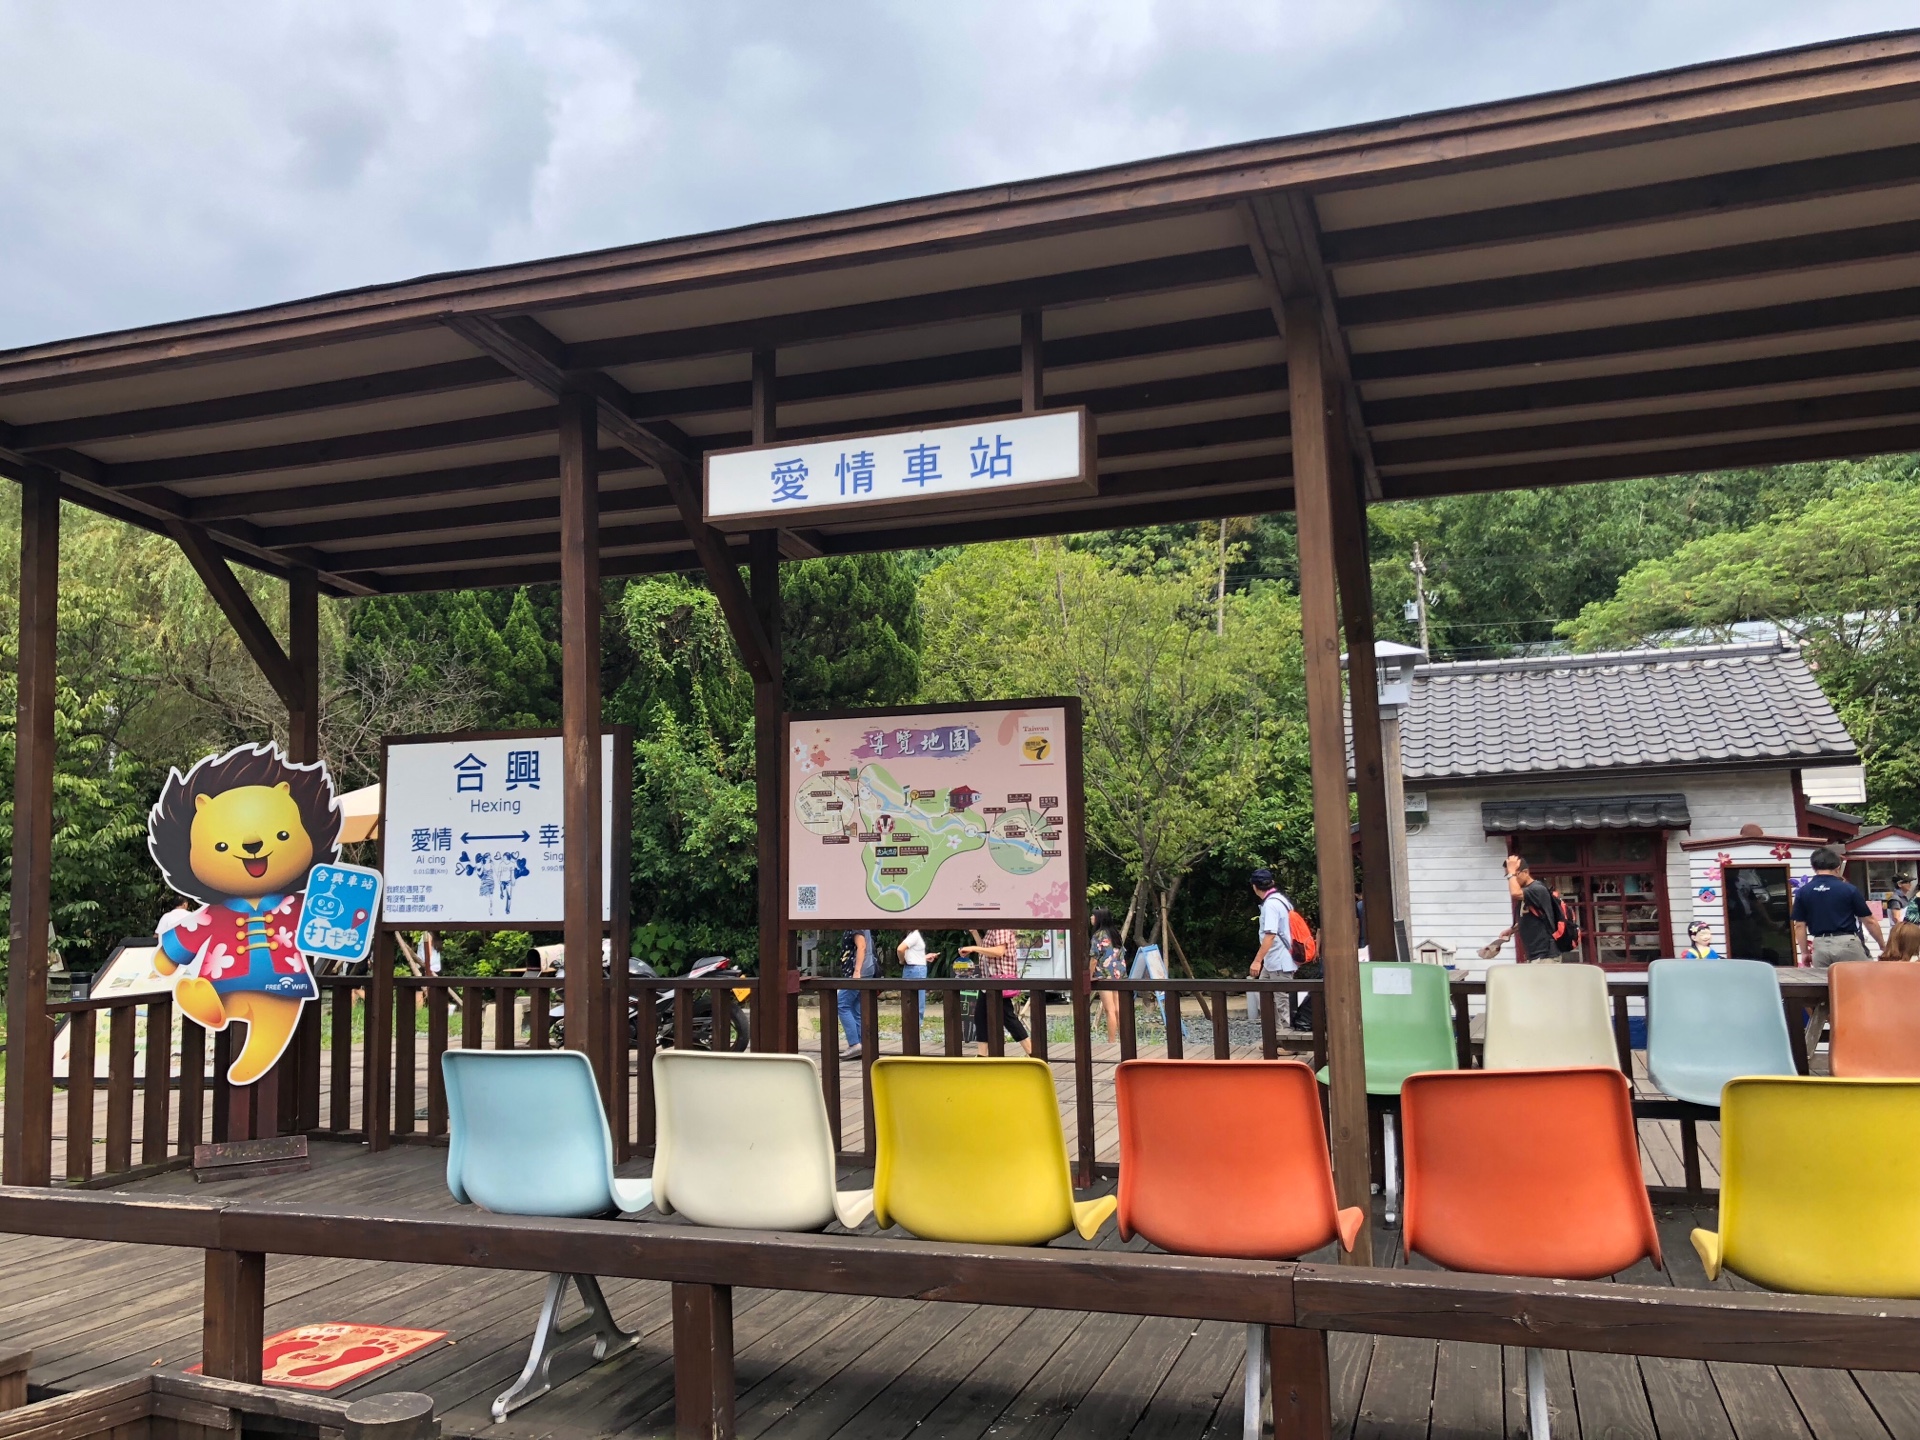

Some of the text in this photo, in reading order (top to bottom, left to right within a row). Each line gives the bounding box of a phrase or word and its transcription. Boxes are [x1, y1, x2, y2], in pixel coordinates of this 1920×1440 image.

[770, 433, 1013, 503] 愛情車站
[869, 728, 970, 755] 導覽地圖
[453, 750, 541, 793] 合興
[470, 798, 521, 815] Hexing
[411, 827, 453, 852] 愛情
[416, 855, 446, 866] Ai cing
[316, 868, 374, 890] 合興車站
[305, 922, 358, 947] 打卡啦
